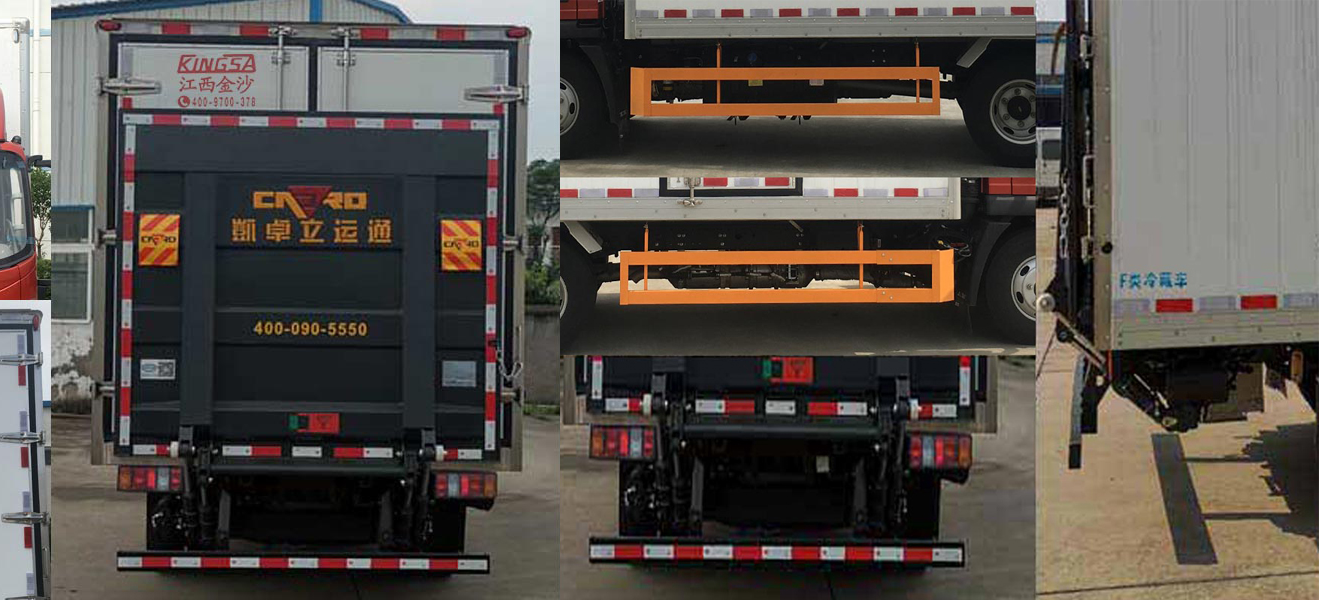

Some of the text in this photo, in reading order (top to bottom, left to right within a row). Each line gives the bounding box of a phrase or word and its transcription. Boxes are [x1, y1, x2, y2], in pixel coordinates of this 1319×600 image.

[177, 53, 256, 74] KINGSA
[179, 74, 255, 94] 江西金沙
[192, 96, 257, 107] 400-9700-378
[253, 321, 368, 337] 400-090-5550
